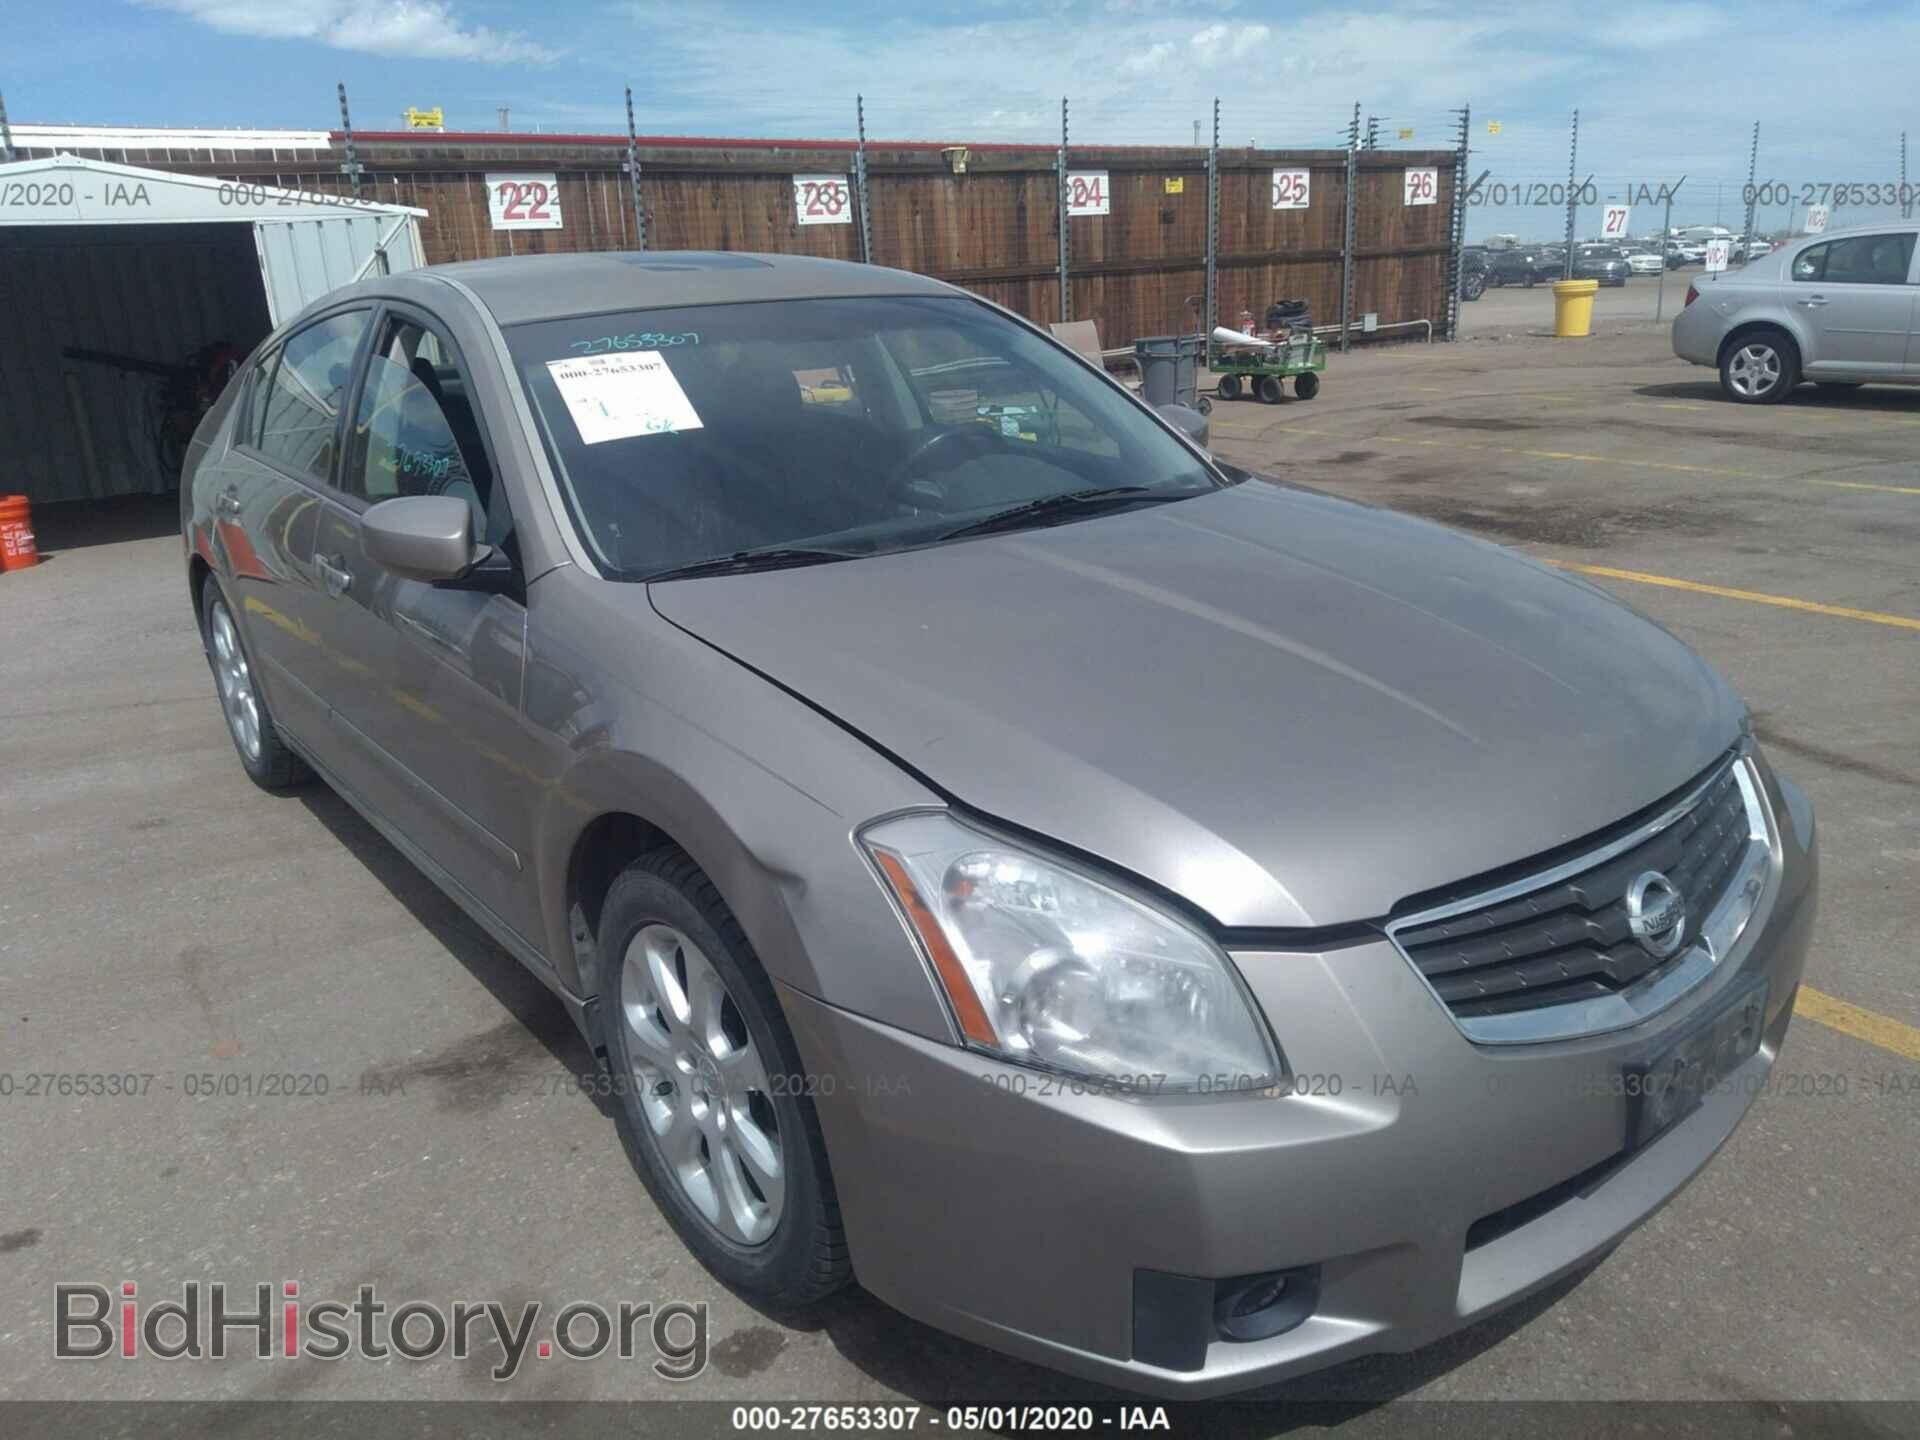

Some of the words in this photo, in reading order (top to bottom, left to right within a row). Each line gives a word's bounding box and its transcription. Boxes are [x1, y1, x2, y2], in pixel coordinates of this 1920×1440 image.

[804, 182, 842, 216] 23
[1072, 176, 1103, 208] 24
[1280, 174, 1304, 202] 25
[1411, 173, 1432, 198] 26
[499, 182, 551, 220] 22
[1607, 210, 1626, 233] 27
[570, 332, 699, 354] 27653307
